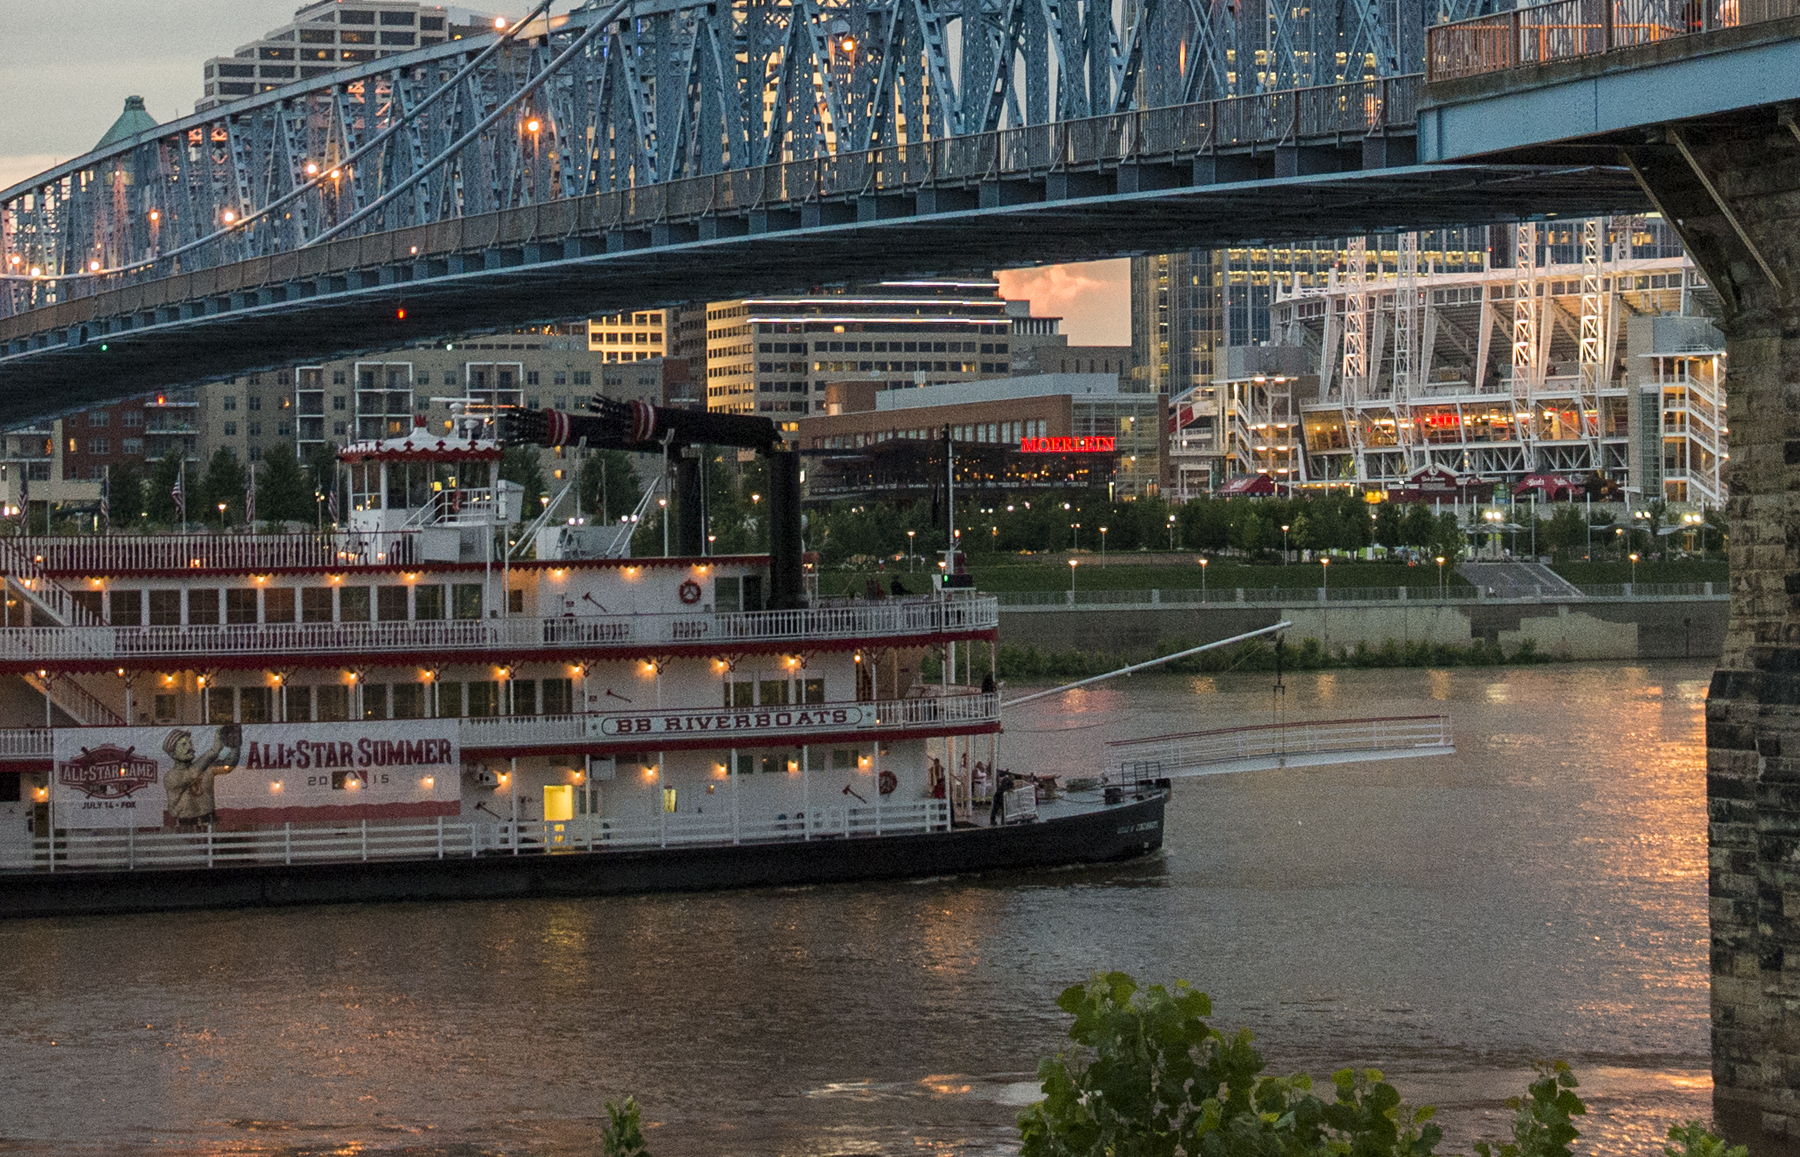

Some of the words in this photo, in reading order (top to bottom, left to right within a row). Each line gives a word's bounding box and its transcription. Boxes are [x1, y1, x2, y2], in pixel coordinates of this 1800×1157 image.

[1021, 436, 1115, 453] MOERLEIN
[616, 718, 651, 733] BB
[664, 709, 848, 731] RIVERBOATS
[358, 737, 452, 767] SUMMER
[121, 762, 154, 778] GAME
[82, 801, 103, 810] JULY
[121, 801, 137, 809] FOX
